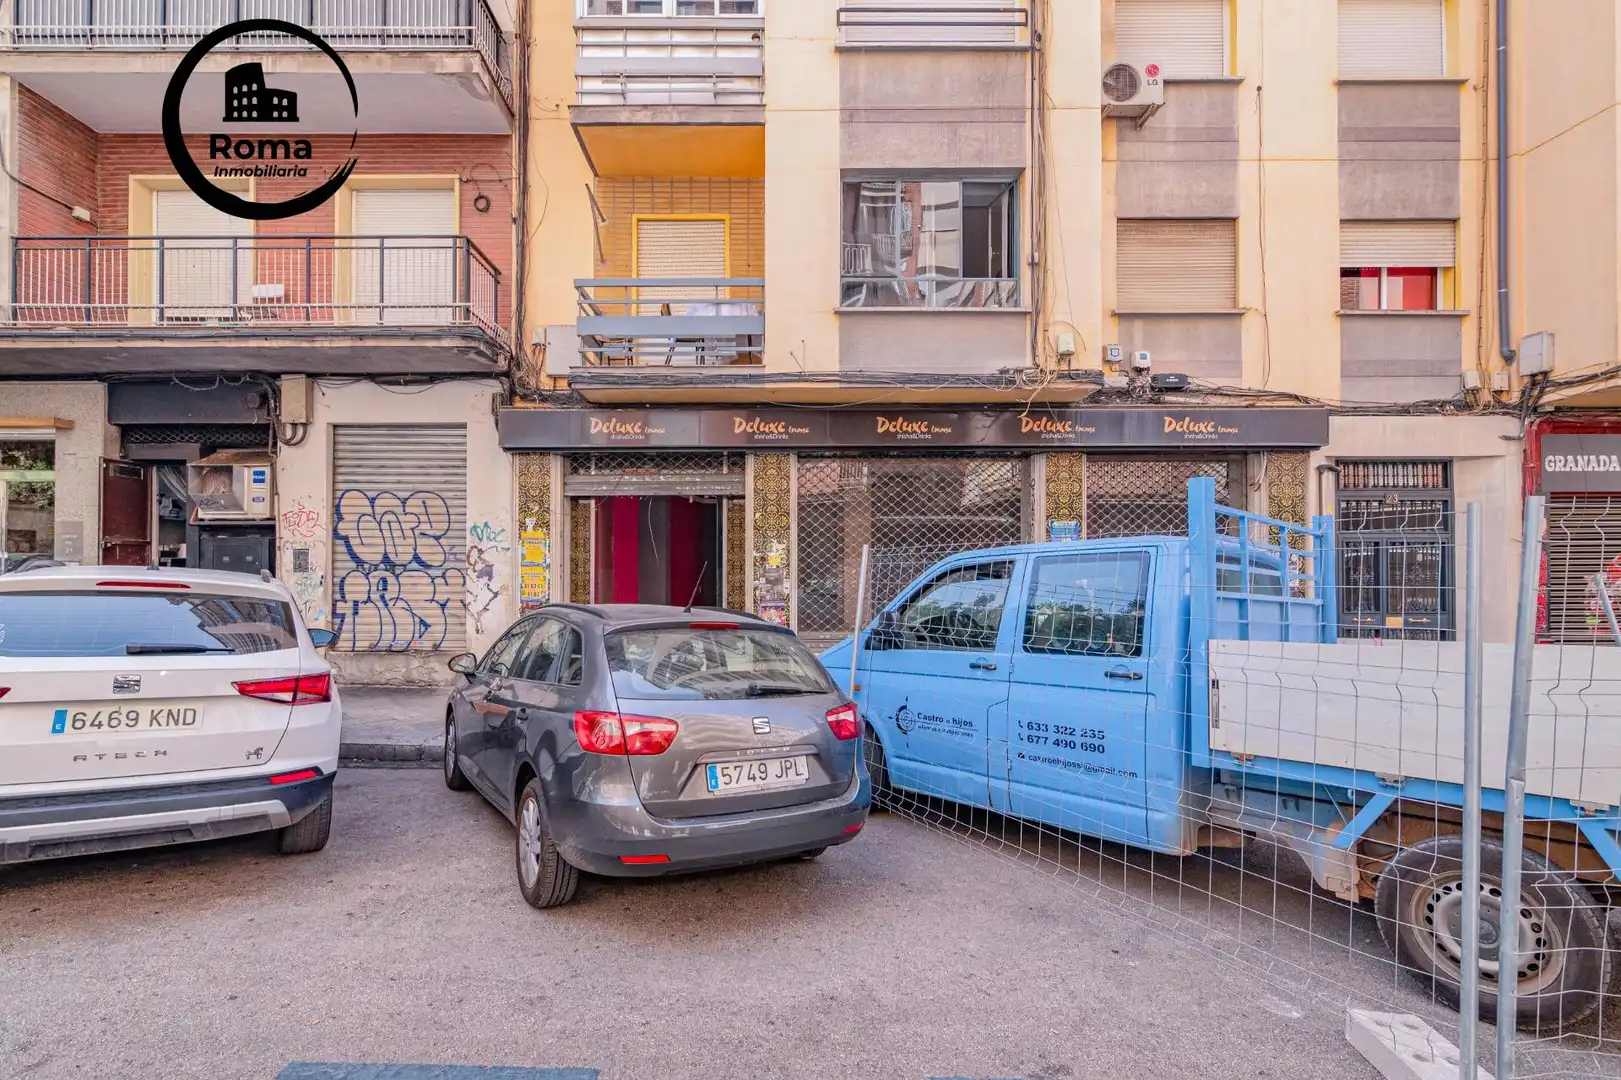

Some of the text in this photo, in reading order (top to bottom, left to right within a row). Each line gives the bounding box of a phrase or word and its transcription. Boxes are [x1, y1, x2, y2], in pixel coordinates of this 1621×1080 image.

[589, 416, 642, 434] Deluxe
[733, 416, 786, 434] Deluxe
[876, 416, 928, 433] Deluxe
[1020, 416, 1073, 433] Deluxe
[1163, 416, 1215, 433] Deluxe
[1544, 454, 1621, 472] GRANADA
[70, 707, 198, 730] 6469 KND
[917, 712, 944, 723] Castro
[952, 716, 974, 728] hijos
[1027, 721, 1106, 740] 633 322 235
[1027, 734, 1105, 754] 677 490 690
[720, 758, 804, 786] 5749 JPL
